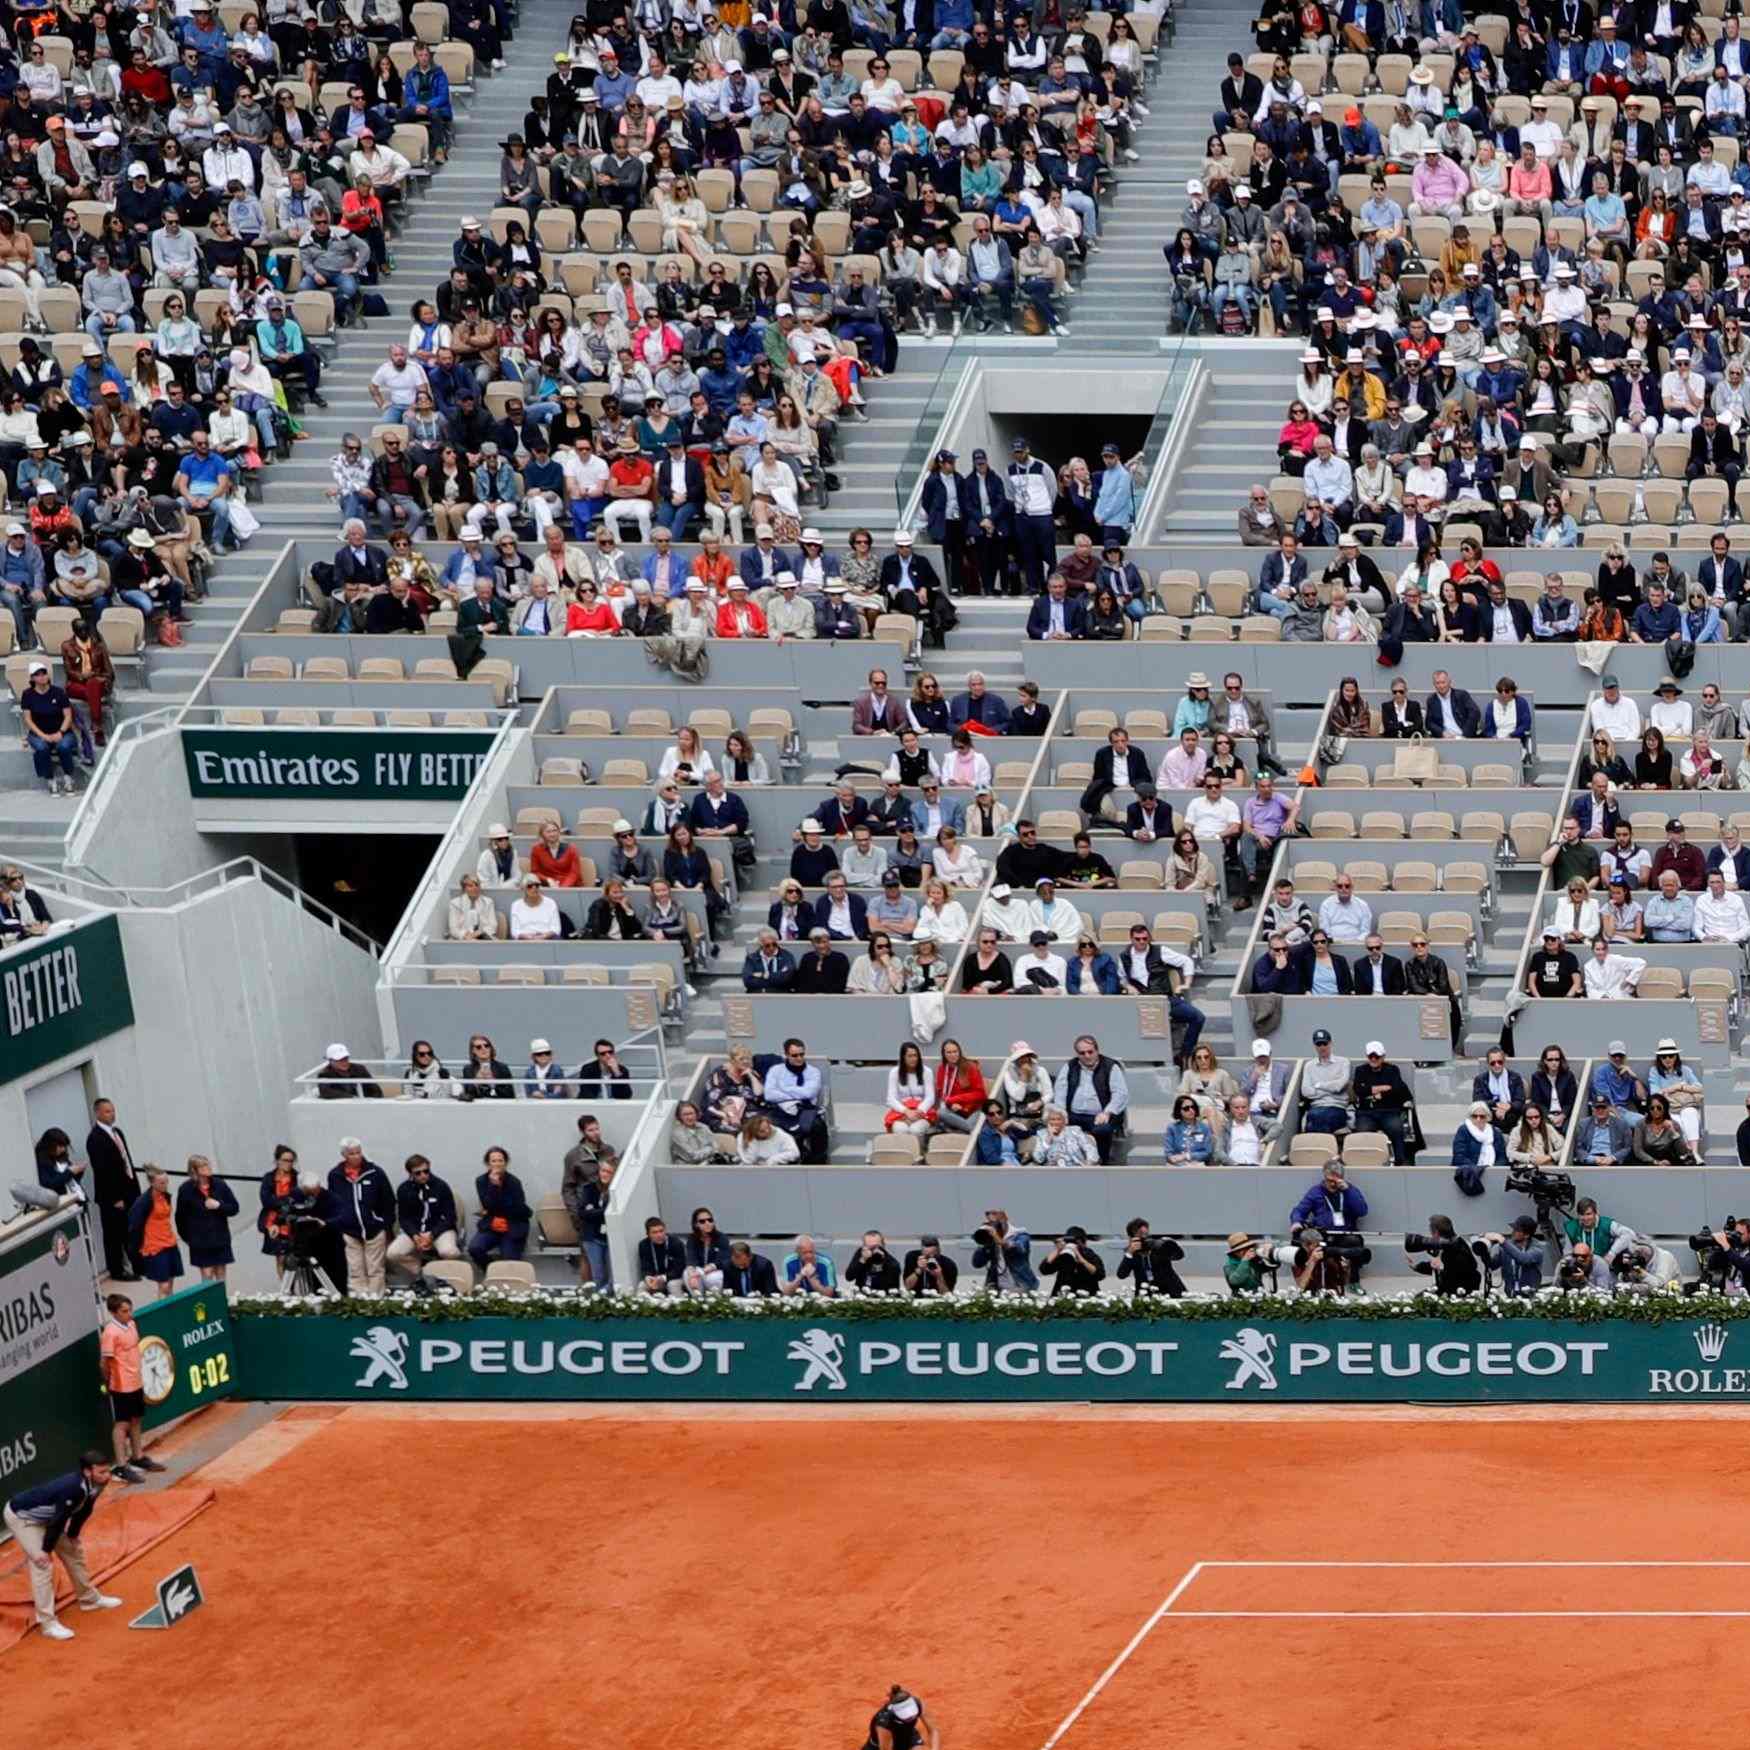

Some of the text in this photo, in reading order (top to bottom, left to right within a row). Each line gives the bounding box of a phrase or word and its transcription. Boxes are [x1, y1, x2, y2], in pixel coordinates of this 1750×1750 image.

[194, 750, 360, 786] Emirates
[375, 753, 413, 786] FLY
[4, 944, 82, 1036] BETTER
[181, 1319, 225, 1348] ROLEX
[188, 1352, 230, 1395] 0:02
[421, 1340, 746, 1376] PEUGEOT
[860, 1342, 1180, 1377] PEUGEOT
[1290, 1342, 1611, 1378] PEUGEOT
[0, 1430, 37, 1480] BAS
